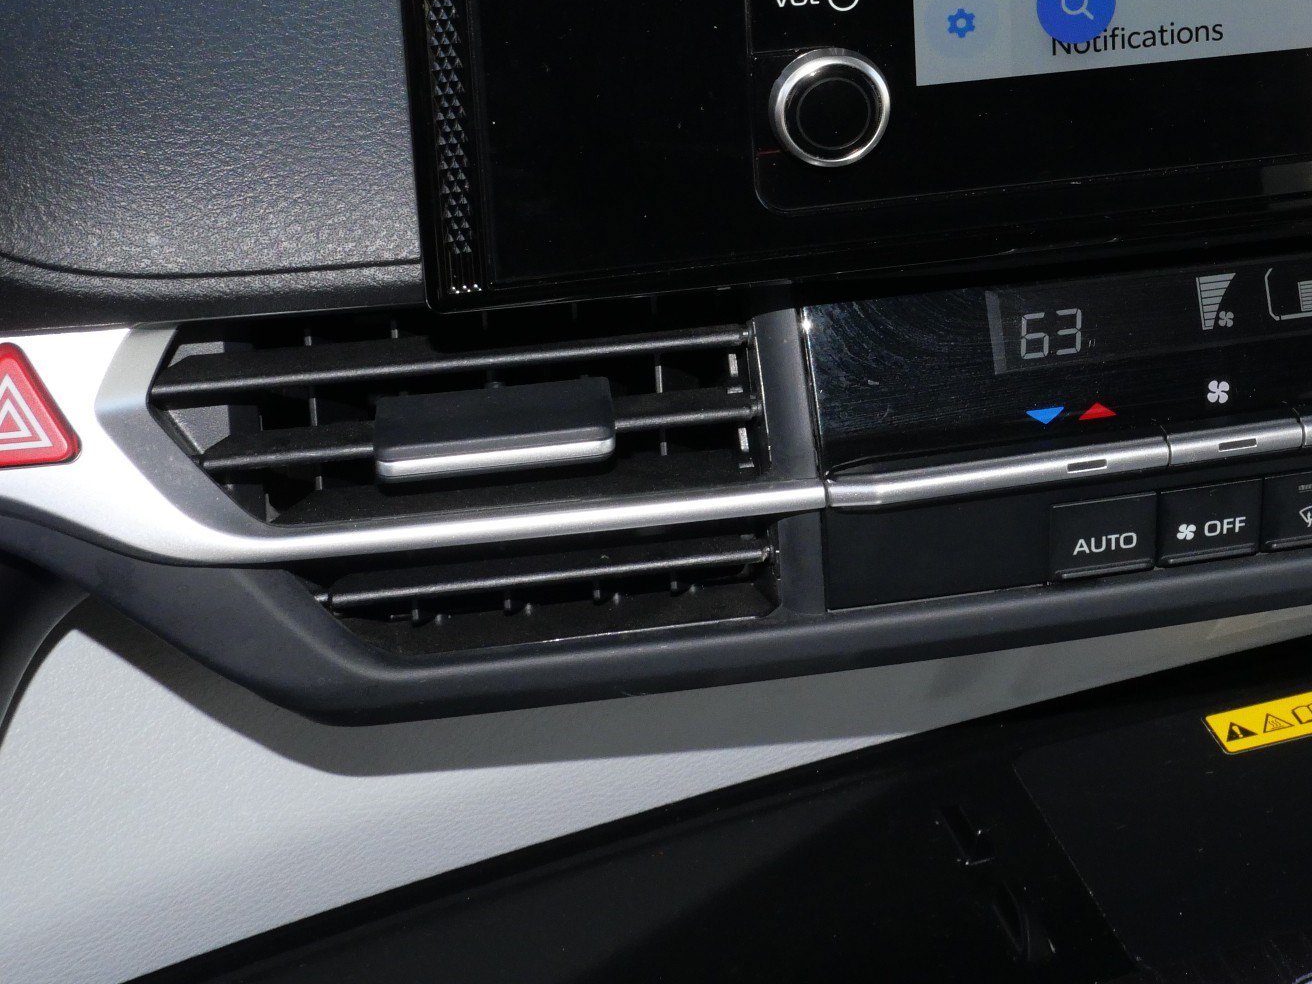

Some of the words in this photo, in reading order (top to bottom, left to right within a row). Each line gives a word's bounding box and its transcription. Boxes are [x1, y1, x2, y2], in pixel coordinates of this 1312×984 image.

[1020, 307, 1082, 359] 63
[1203, 516, 1246, 537] OFF
[1073, 532, 1137, 555] AUTO
